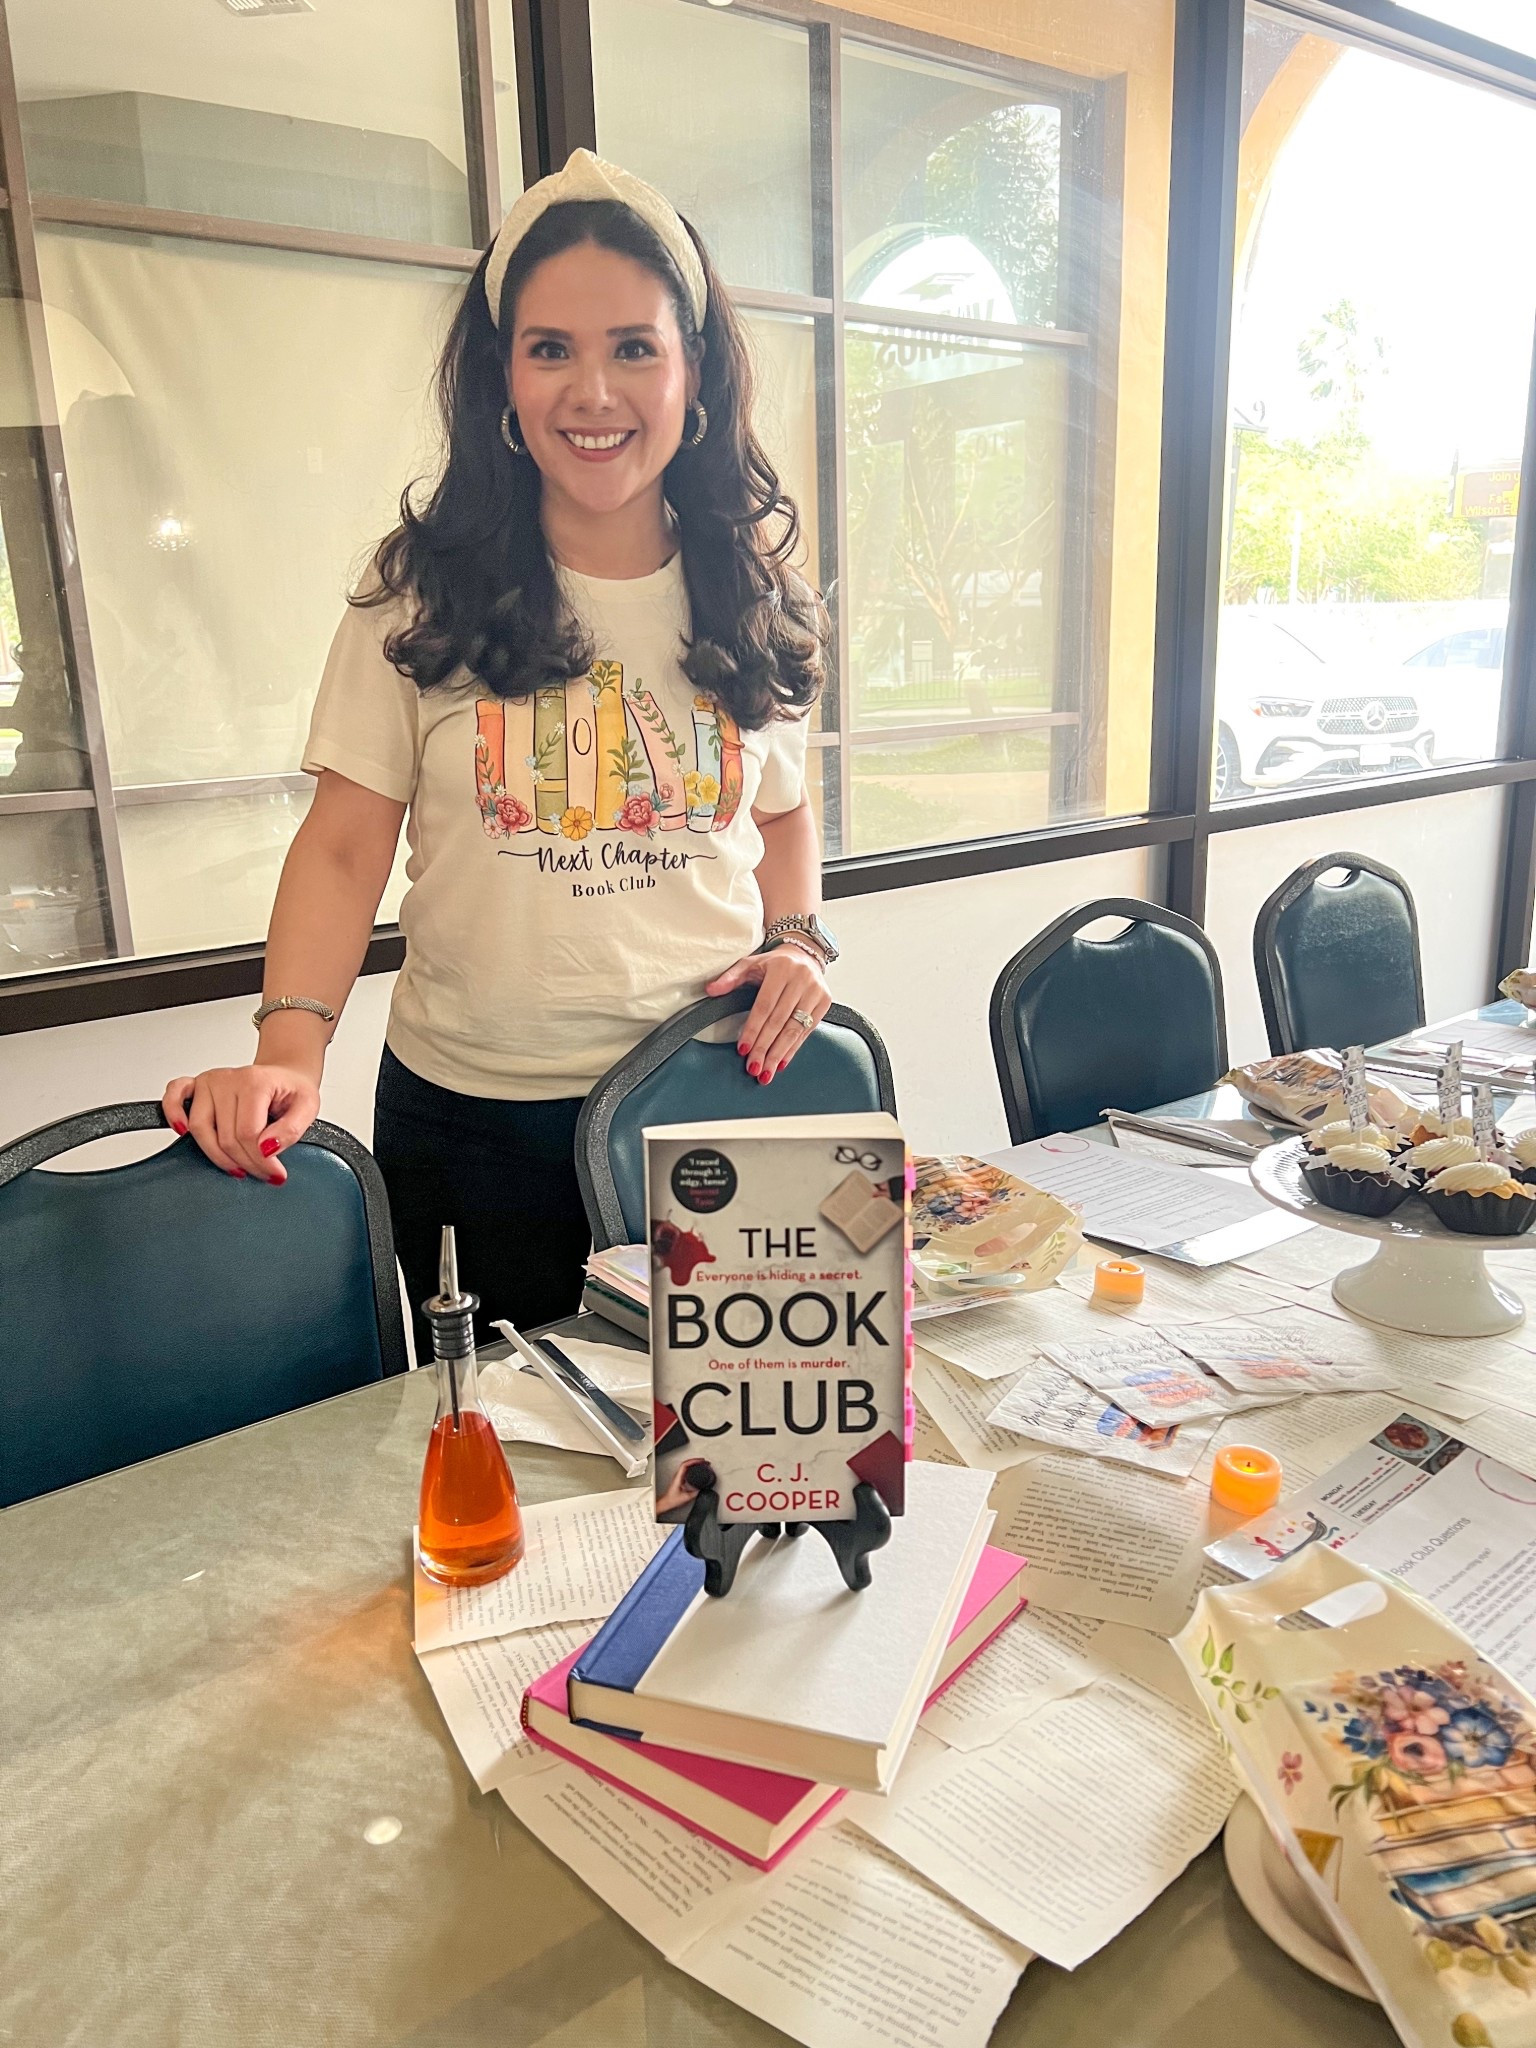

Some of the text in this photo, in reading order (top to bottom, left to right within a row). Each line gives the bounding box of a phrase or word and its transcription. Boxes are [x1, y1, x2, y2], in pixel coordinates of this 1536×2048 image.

[1489, 472, 1511, 481] Join
[1465, 505, 1500, 517] Wilson
[536, 841, 690, 874] Next Chapter
[572, 875, 657, 897] Book Club
[1440, 1086, 1460, 1097] BOOK
[1442, 1097, 1460, 1109] CLUB
[1474, 1107, 1493, 1118] BOOK
[1475, 1120, 1494, 1131] CLUB
[680, 1168, 713, 1178] through
[739, 1227, 817, 1259] THE
[696, 1269, 863, 1284] Everyone is hiding a secret.
[667, 1291, 889, 1349] BOOK
[708, 1357, 850, 1371] One of them is murder.
[681, 1380, 879, 1437] CLUB
[757, 1463, 809, 1484] C. J.
[725, 1490, 840, 1512] COOPER
[1320, 1483, 1344, 1502] MONDAY
[1351, 1499, 1377, 1519] TUESDAY
[1391, 1517, 1471, 1577] Book Club Questions
